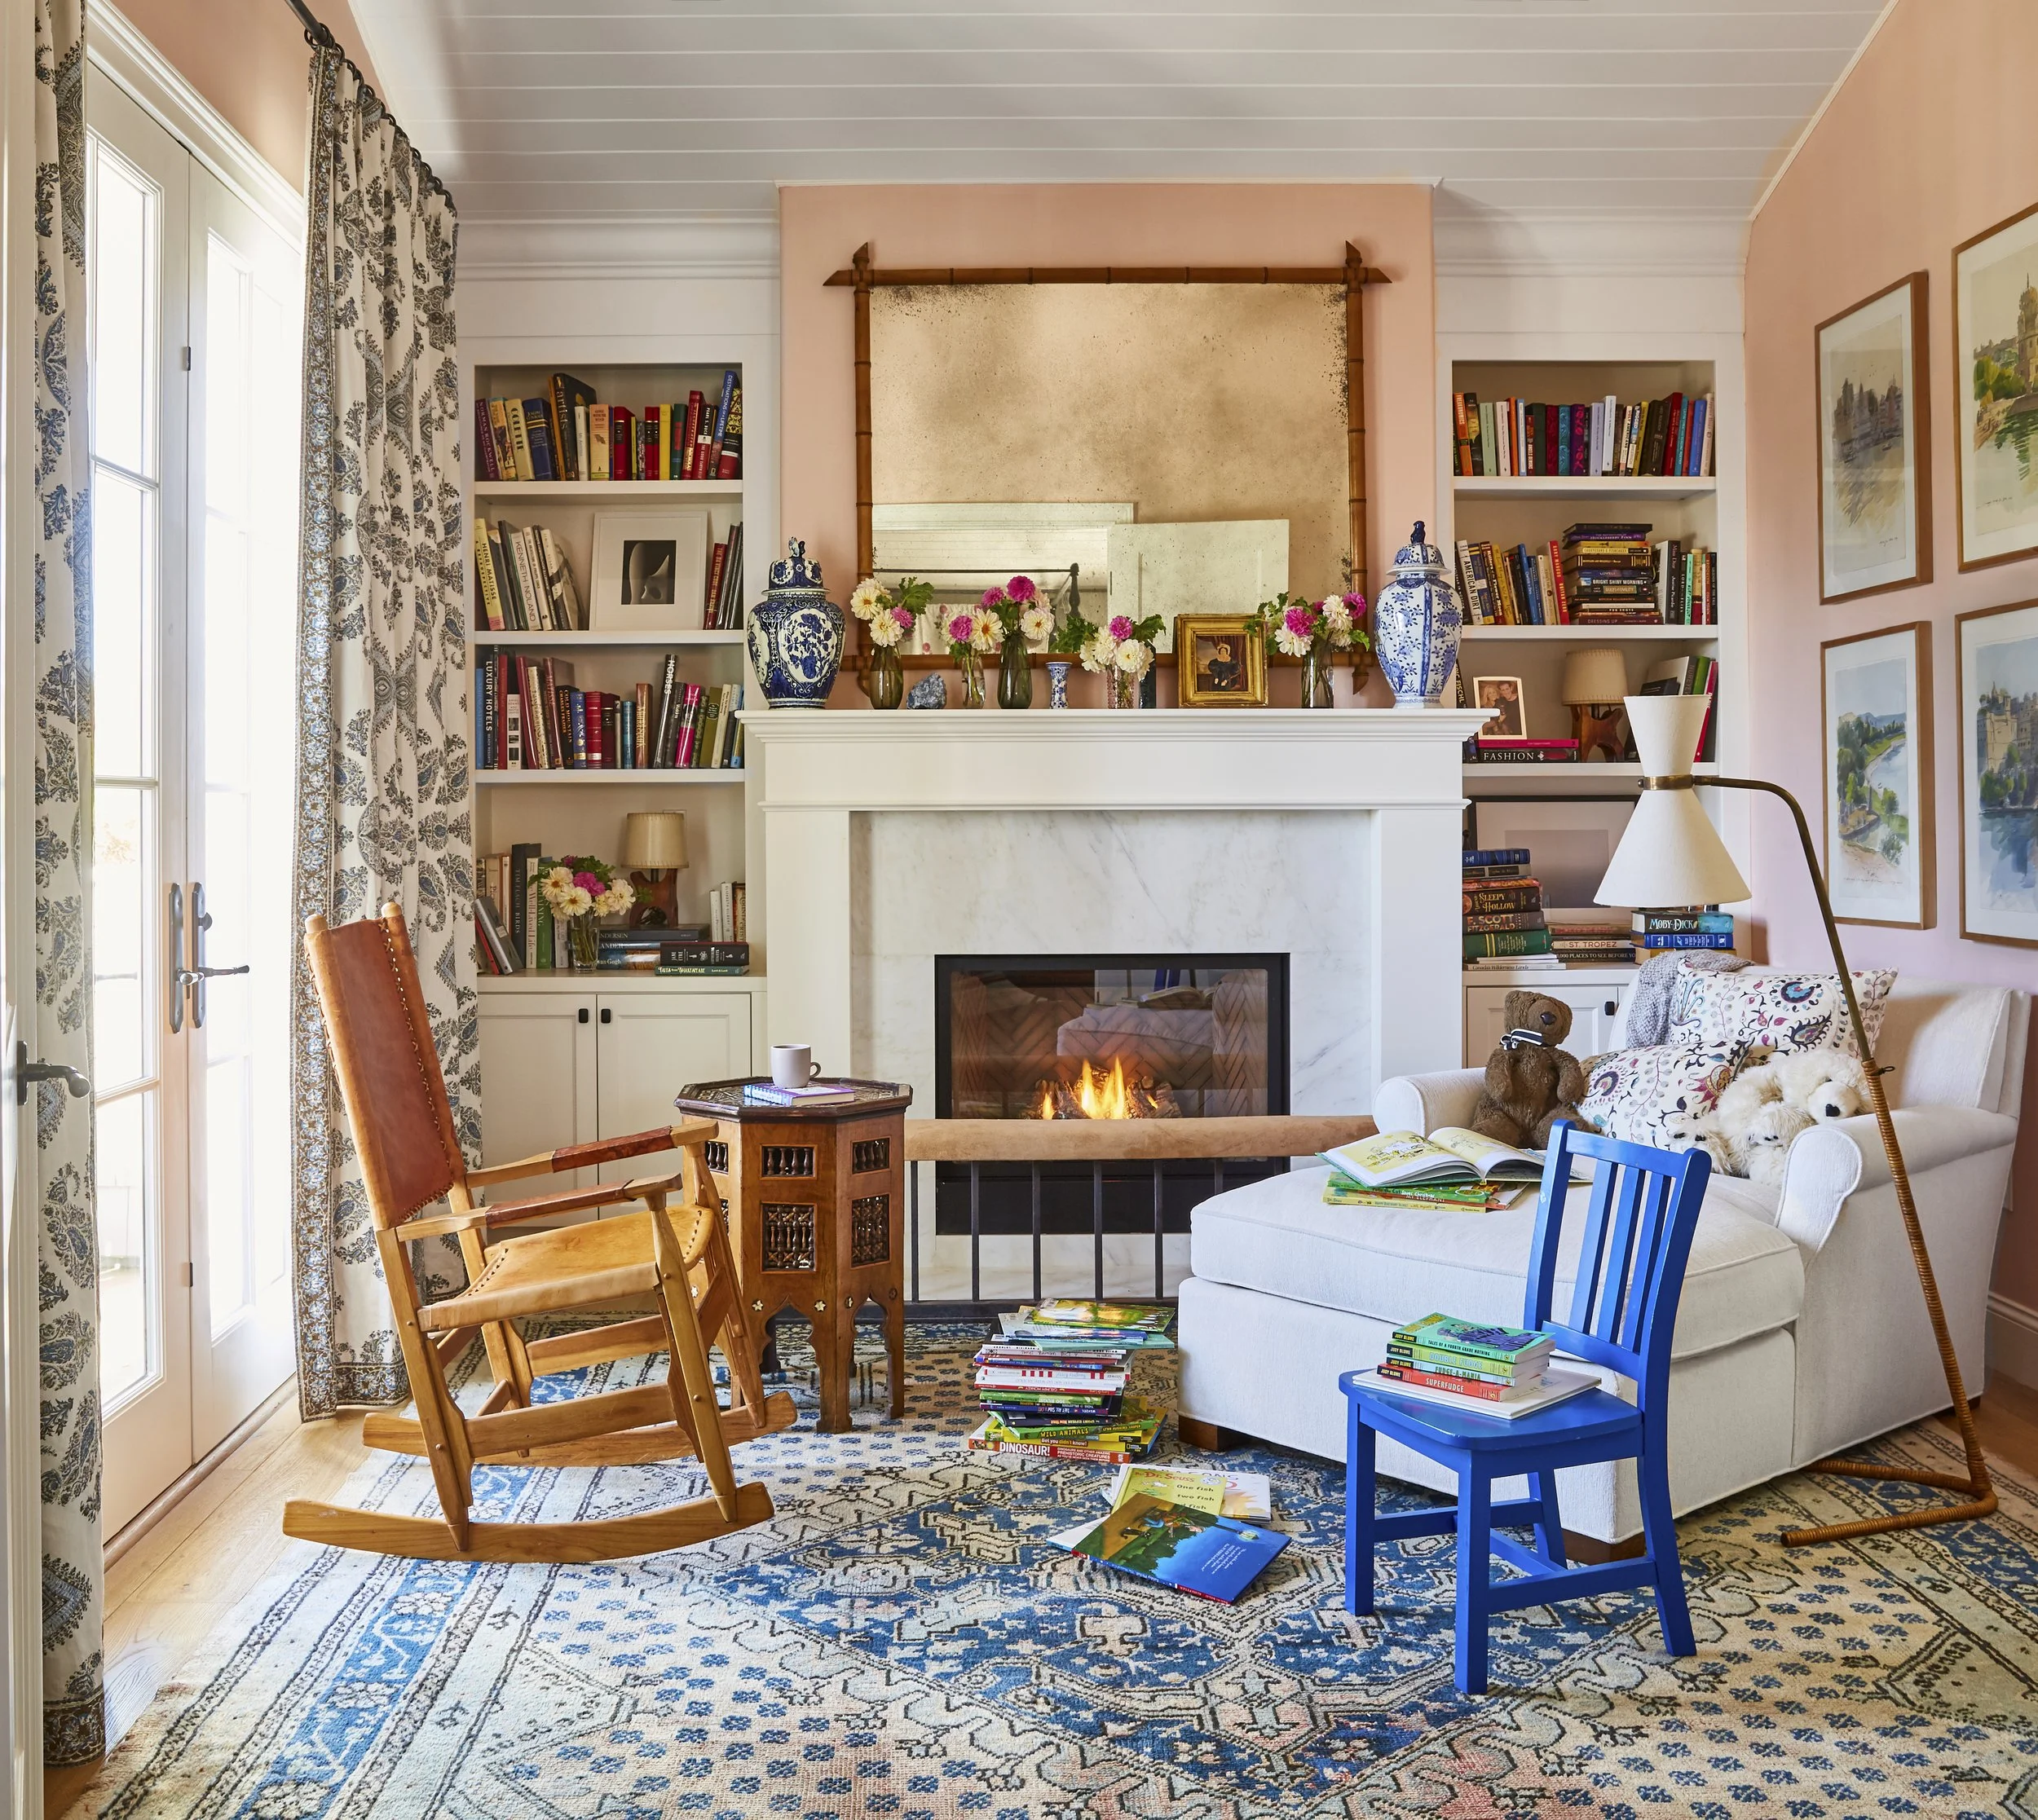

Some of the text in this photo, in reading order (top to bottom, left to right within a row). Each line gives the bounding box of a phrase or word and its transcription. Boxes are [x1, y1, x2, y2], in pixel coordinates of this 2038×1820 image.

[556, 391, 568, 430] artists
[717, 375, 733, 437] DESTINATIONS LIFETIME
[1456, 394, 1465, 425] FREAKONOMICS
[479, 401, 487, 432] NORMAN
[484, 433, 495, 472] ROCKWELL
[476, 549, 491, 606] RETROSPECTIVE
[482, 543, 496, 600] HENRI MATISSE
[515, 541, 536, 622] KENNETH NOLAND
[1464, 561, 1480, 610] AMERICAN DIRT
[664, 660, 676, 694] HORSES
[1456, 680, 1465, 703] FISCHL
[1484, 752, 1534, 761] FASHION
[1479, 892, 1506, 902] SLEEPY
[1482, 901, 1515, 913] HOLLOW
[528, 892, 537, 950] Well-Lived Life
[1467, 914, 1514, 925] F. SCOTT
[1467, 923, 1515, 932] FITZGERALD
[1649, 918, 1694, 931] MOBY-DICK
[1429, 1352, 1483, 1369] DOUBLE FUDGE
[1474, 1348, 1490, 1356] NOTHING
[1435, 1366, 1481, 1380] FUDGE-A-MANIA
[1426, 1377, 1464, 1393] SUPERFUDGE
[999, 1442, 1050, 1456] DINOSAUR!
[1164, 1474, 1195, 1482] Seuss
